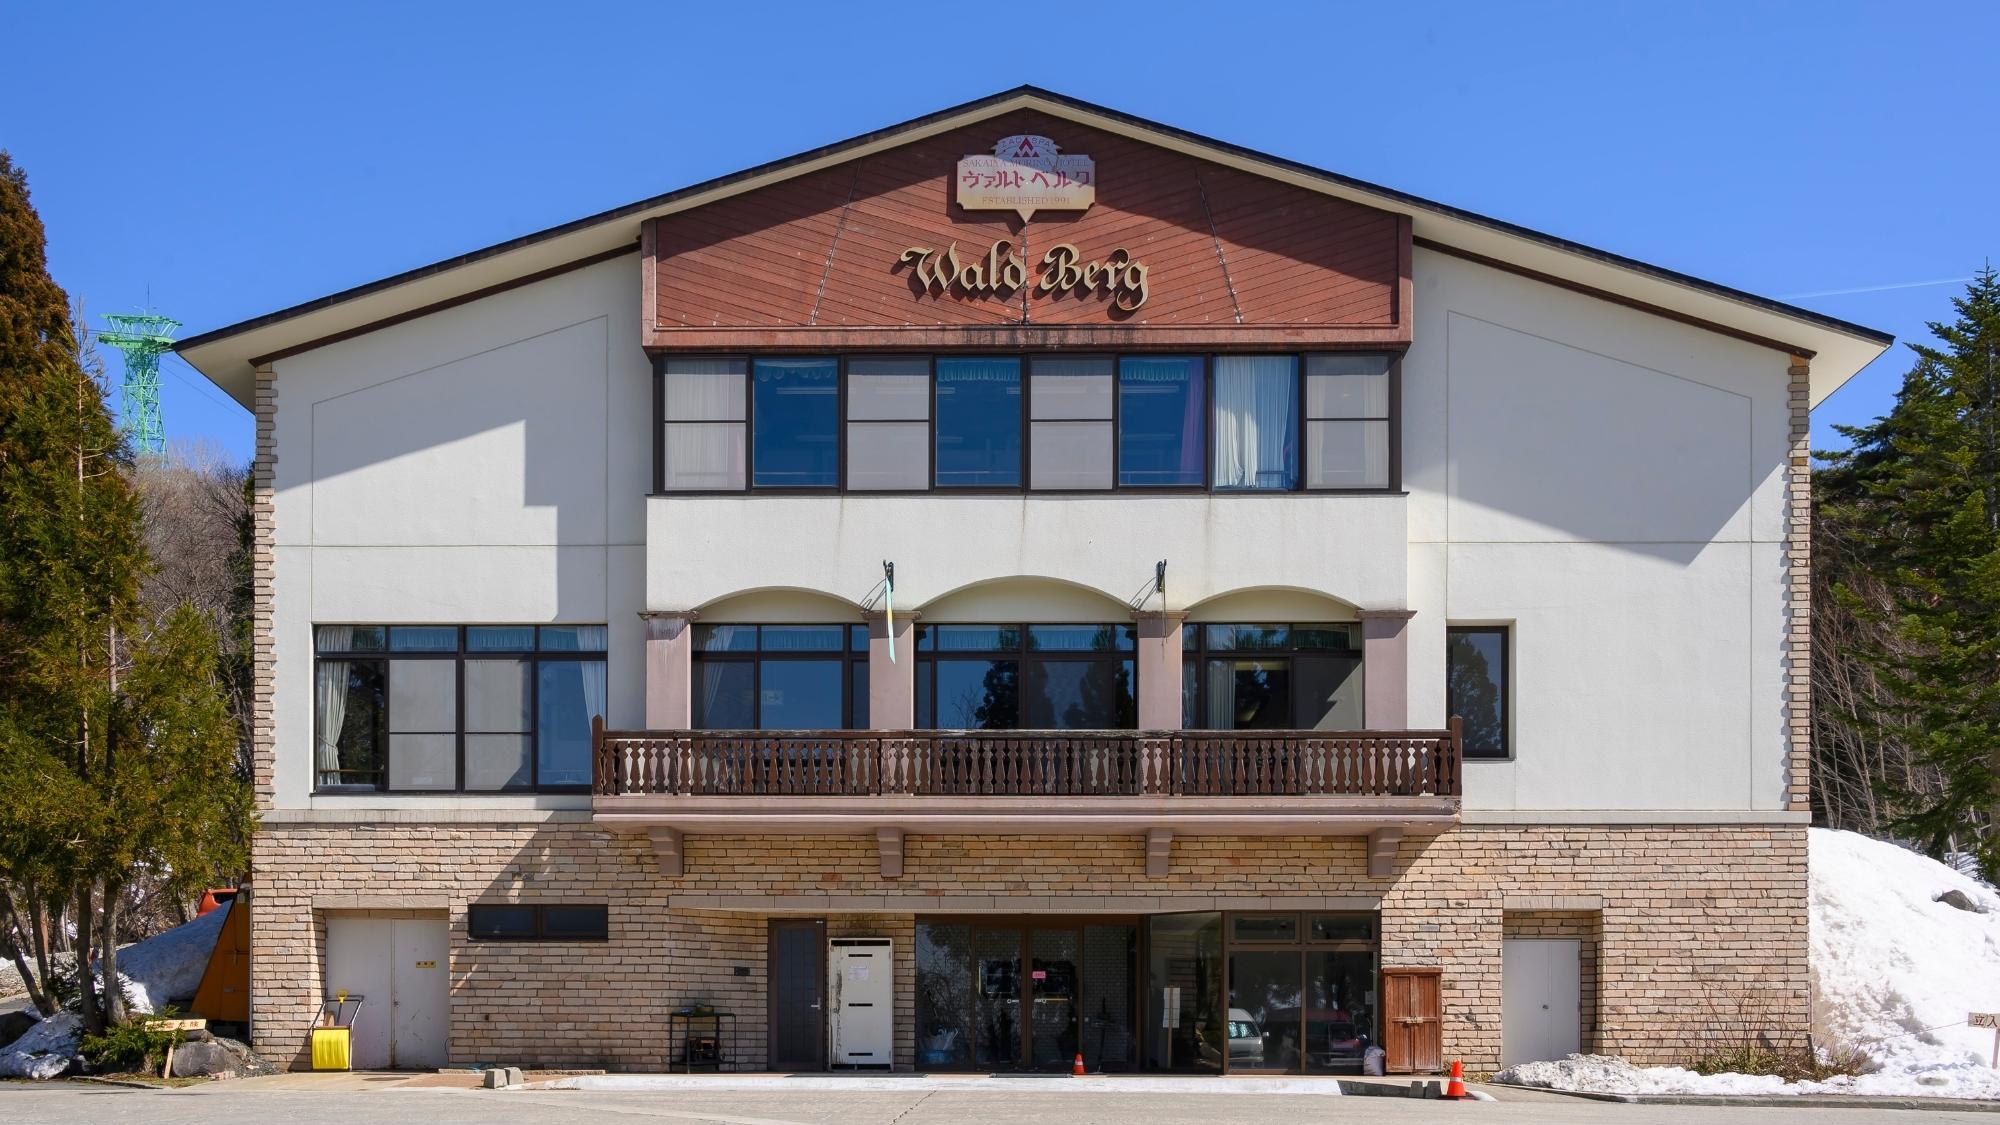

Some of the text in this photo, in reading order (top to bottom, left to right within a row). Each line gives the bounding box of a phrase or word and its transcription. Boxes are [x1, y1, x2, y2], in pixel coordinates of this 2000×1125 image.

[1032, 137, 1050, 147] SPA
[982, 196, 1071, 205] ESTABLISHED 1991
[900, 239, 1149, 311] Wald Berg
[1973, 1013, 1998, 1028] 立入
